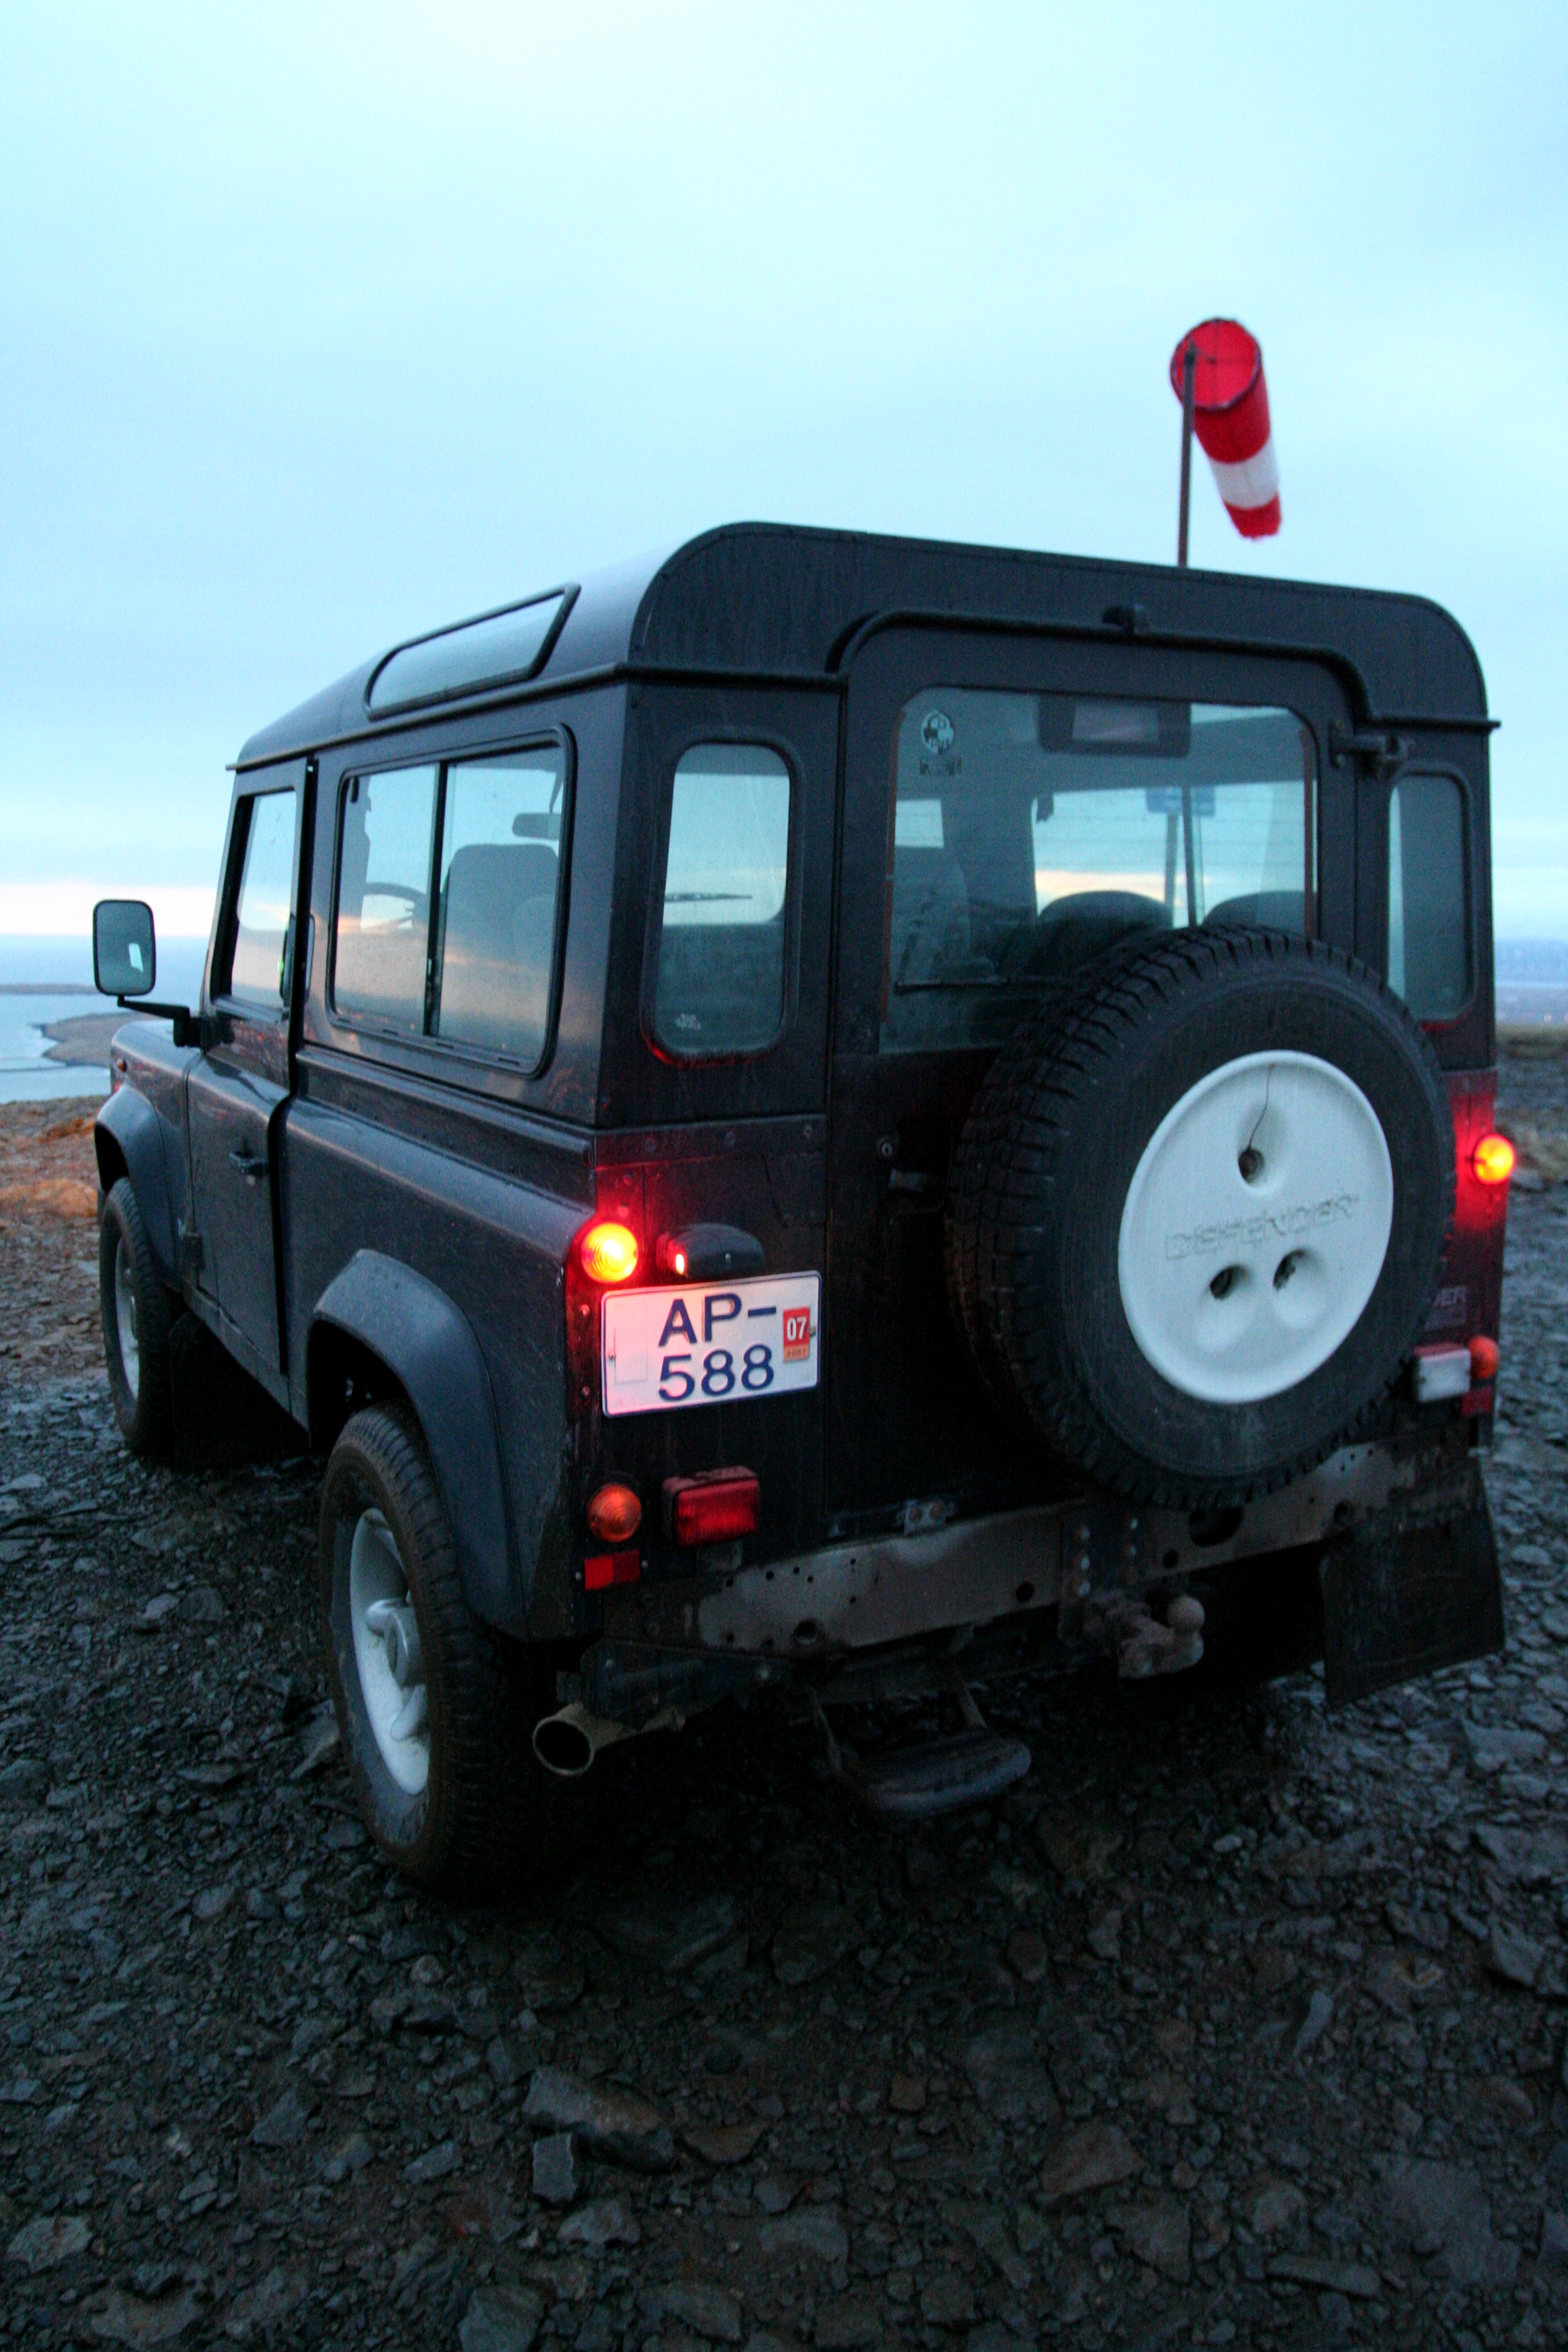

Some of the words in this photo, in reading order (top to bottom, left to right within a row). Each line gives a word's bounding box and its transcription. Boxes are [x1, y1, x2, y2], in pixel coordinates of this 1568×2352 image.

[658, 1293, 777, 1348] AP-
[786, 1316, 807, 1341] 07
[658, 1344, 774, 1402] 588
